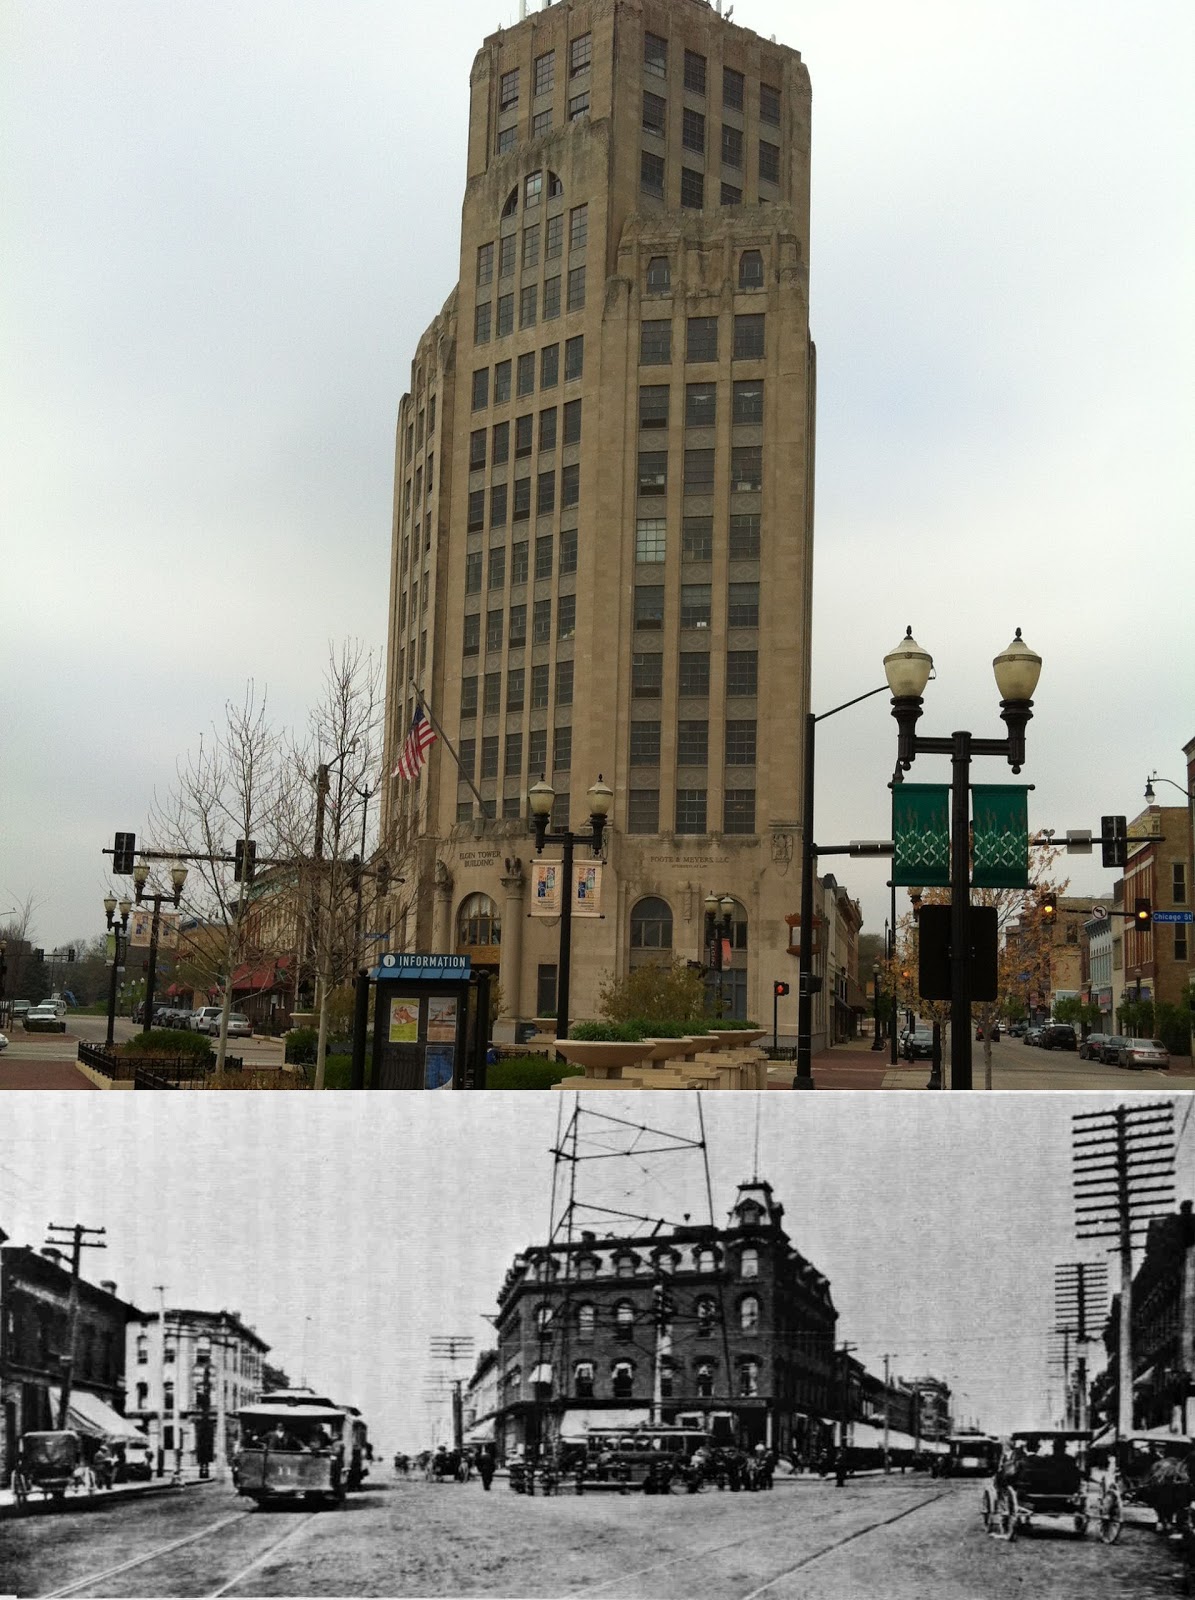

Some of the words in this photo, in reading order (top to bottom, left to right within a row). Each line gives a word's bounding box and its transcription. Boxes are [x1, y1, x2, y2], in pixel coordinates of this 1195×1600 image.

[460, 852, 476, 860] ELGIN
[478, 850, 502, 858] TOWER
[464, 859, 494, 867] BUILDING
[1153, 913, 1181, 921] Chicago
[1184, 912, 1192, 920] St
[399, 956, 466, 967] INFORMATION
